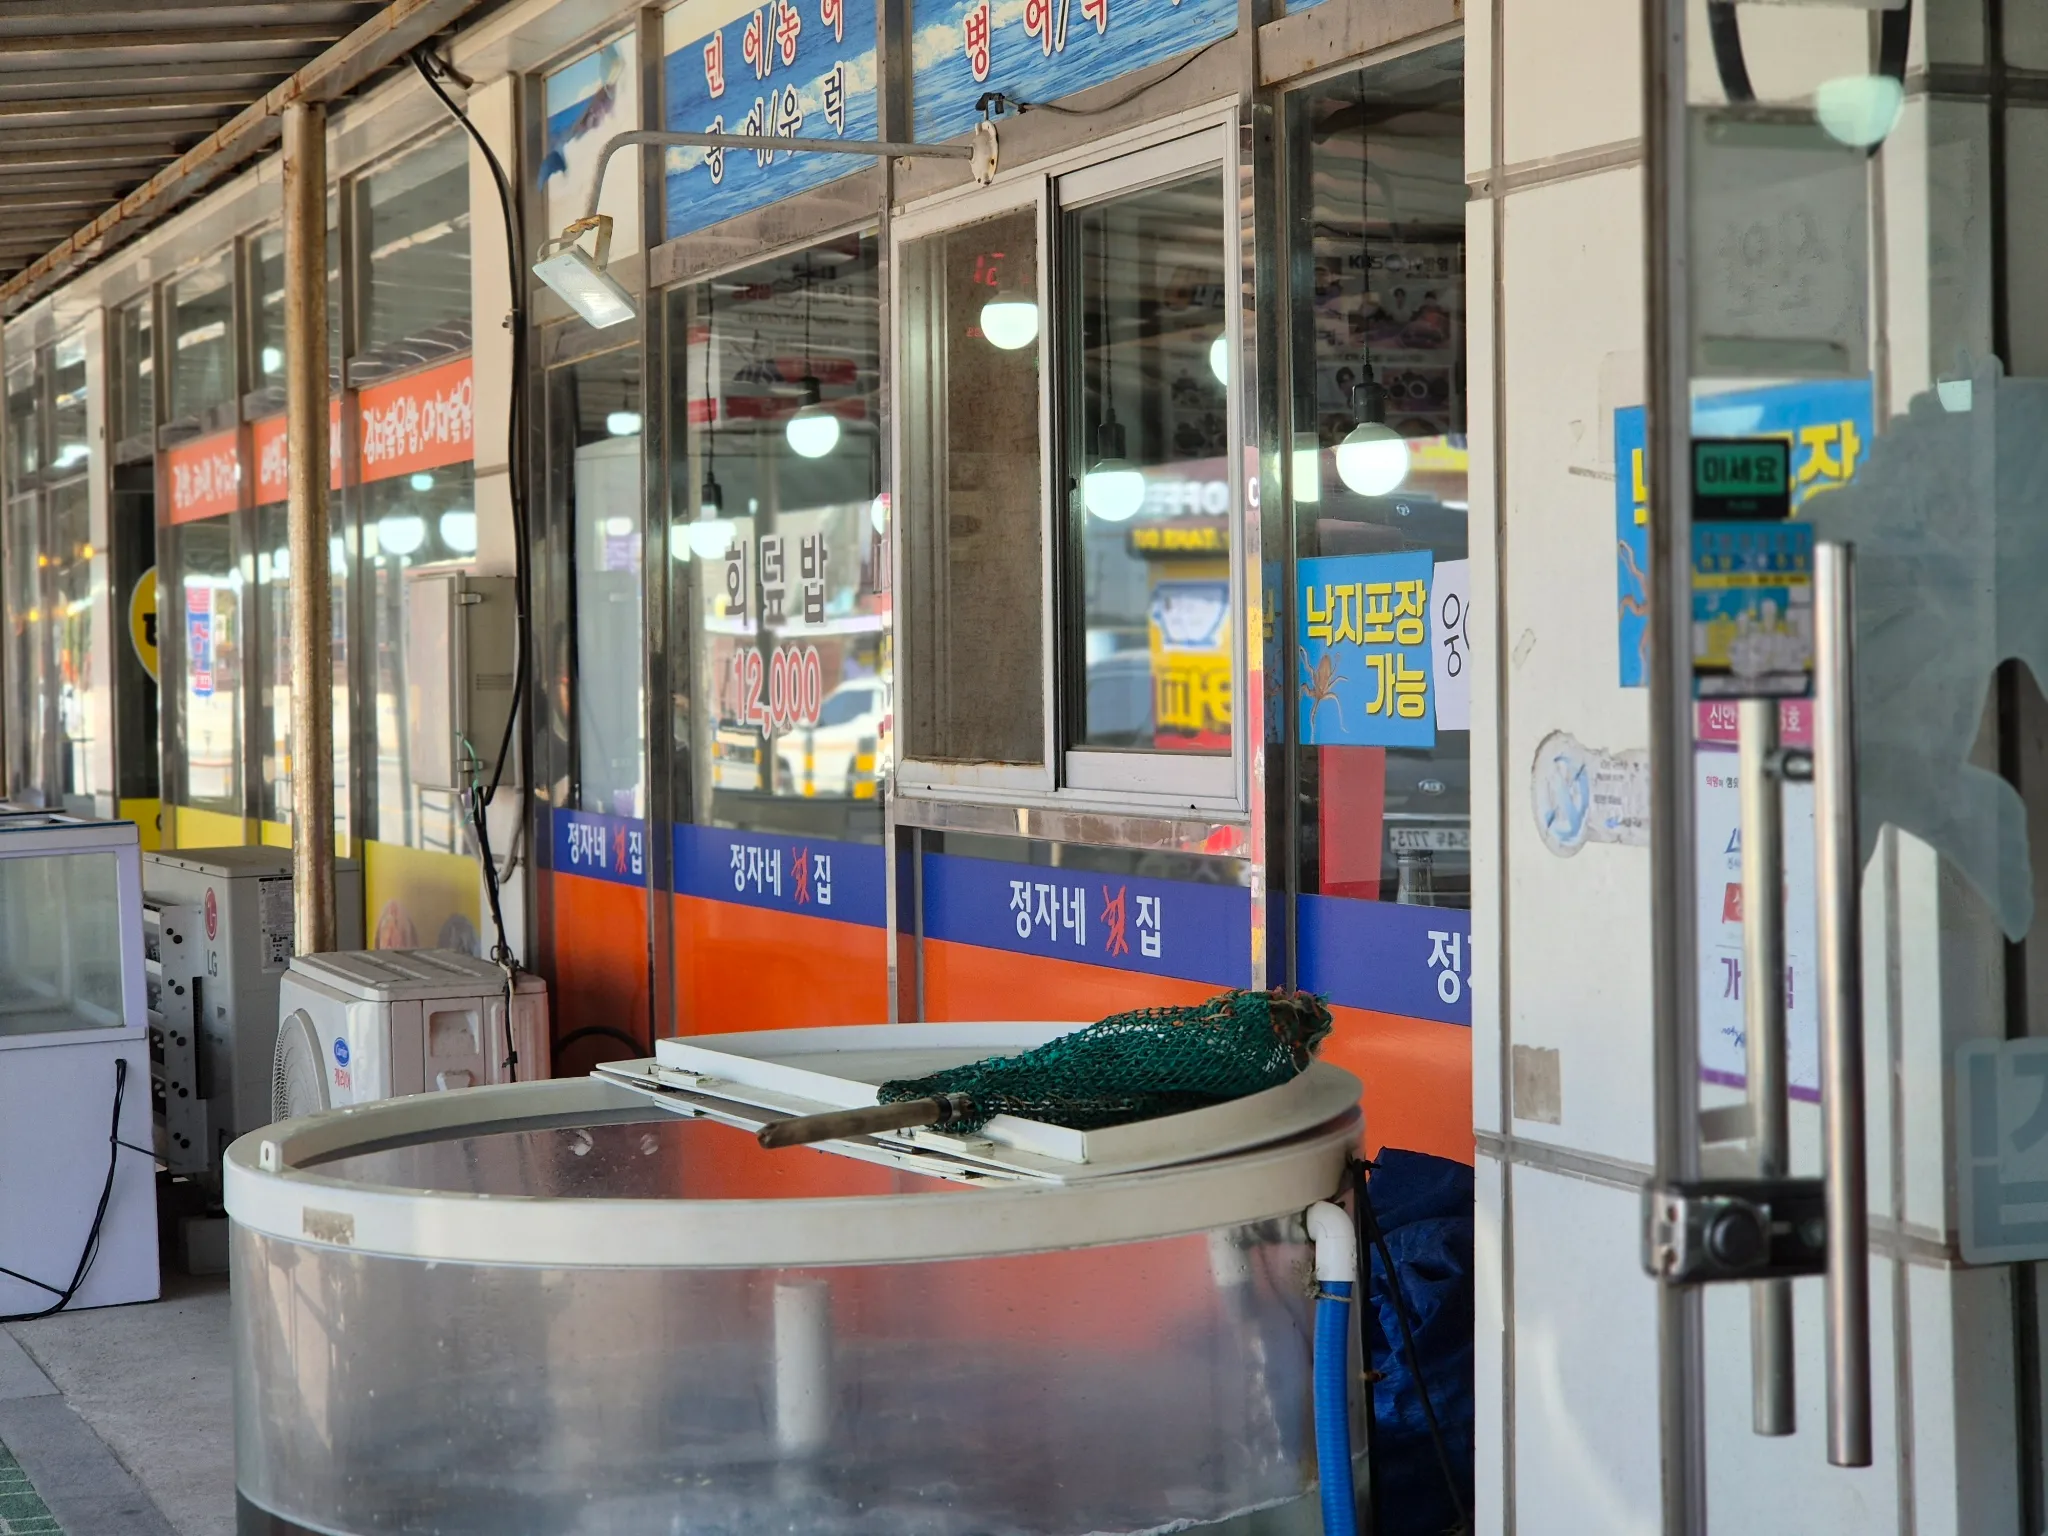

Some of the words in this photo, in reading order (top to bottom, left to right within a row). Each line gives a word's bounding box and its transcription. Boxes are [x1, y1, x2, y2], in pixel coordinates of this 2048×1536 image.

[1702, 455, 1778, 484] 미세요
[1306, 578, 1428, 647] 낙지포장
[733, 648, 821, 737] 12,000
[1365, 652, 1428, 718] 가능
[567, 822, 606, 867] 정자네
[730, 844, 782, 896] 정자네
[1009, 880, 1086, 946] 정자네
[207, 949, 218, 977] LG
